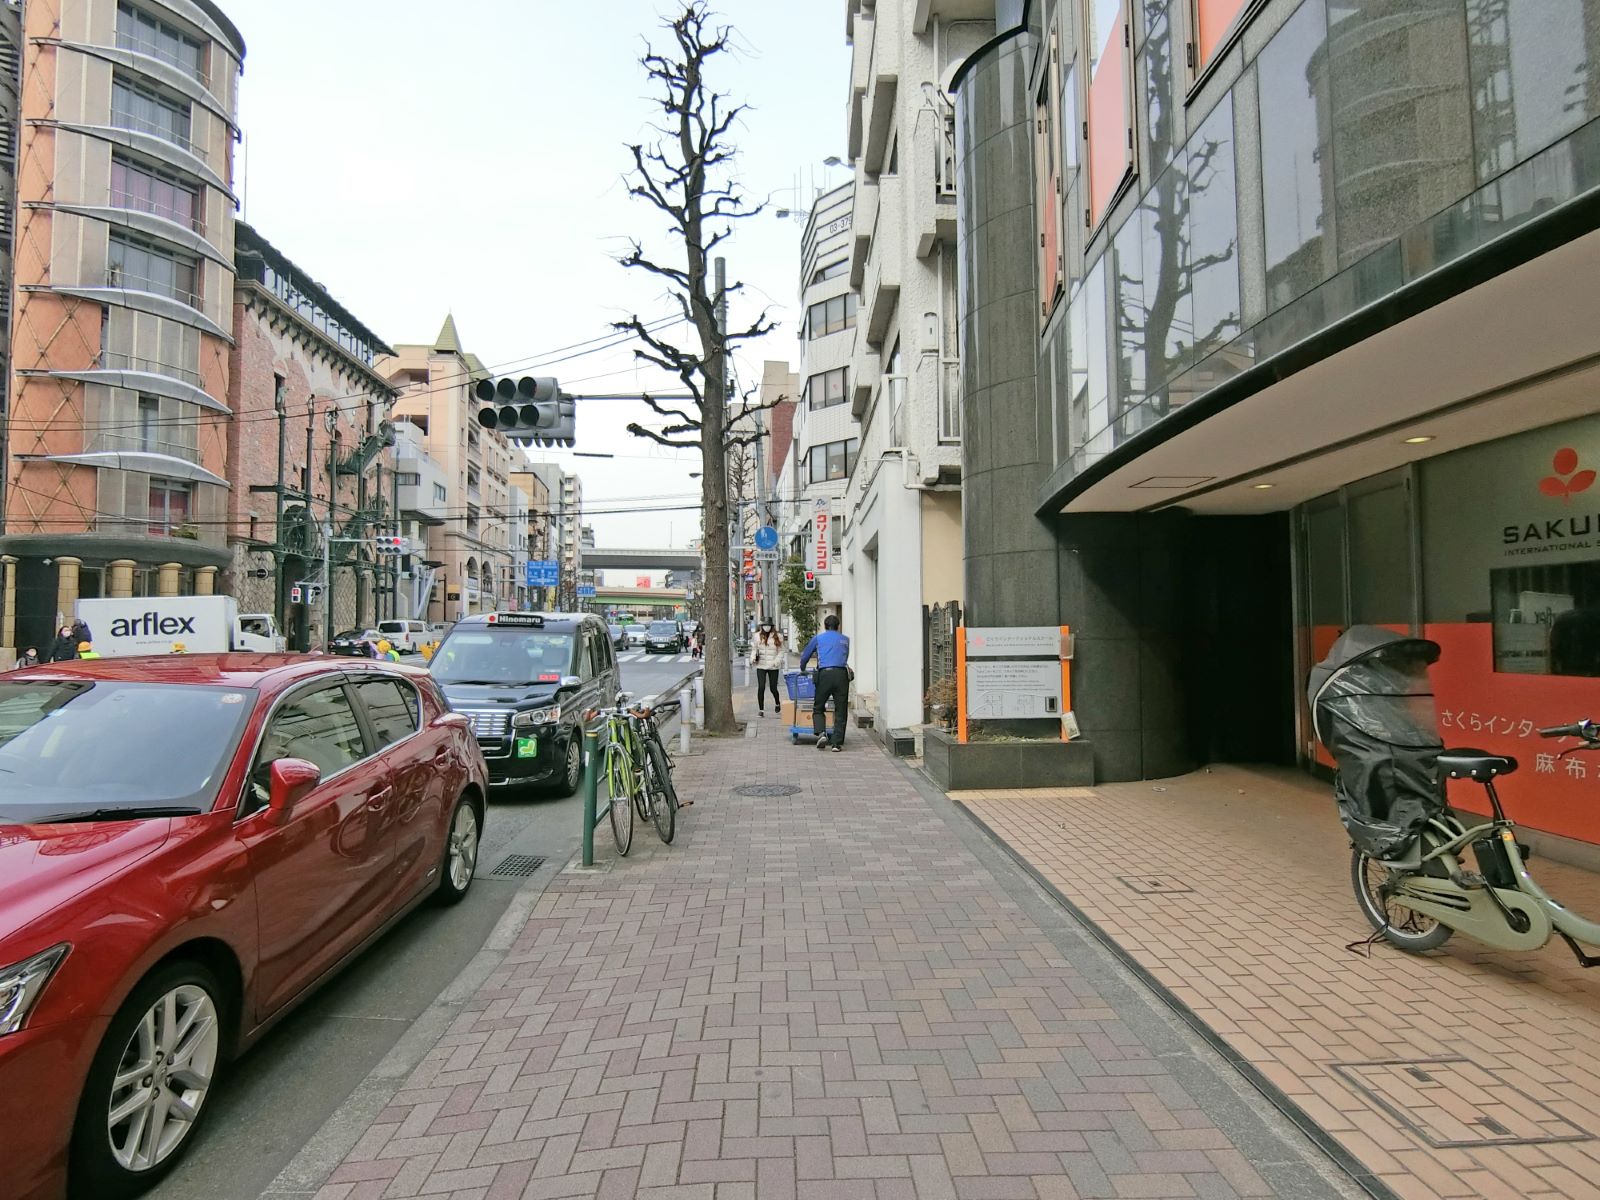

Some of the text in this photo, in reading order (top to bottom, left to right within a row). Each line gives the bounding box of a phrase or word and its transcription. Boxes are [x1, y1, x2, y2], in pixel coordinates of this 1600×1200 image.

[1503, 514, 1600, 544] SAKU
[1504, 541, 1591, 557] INTERNATIONAL
[110, 611, 195, 637] arflex
[499, 614, 541, 624] Hinomaru
[1441, 708, 1567, 743] さくらインタ
